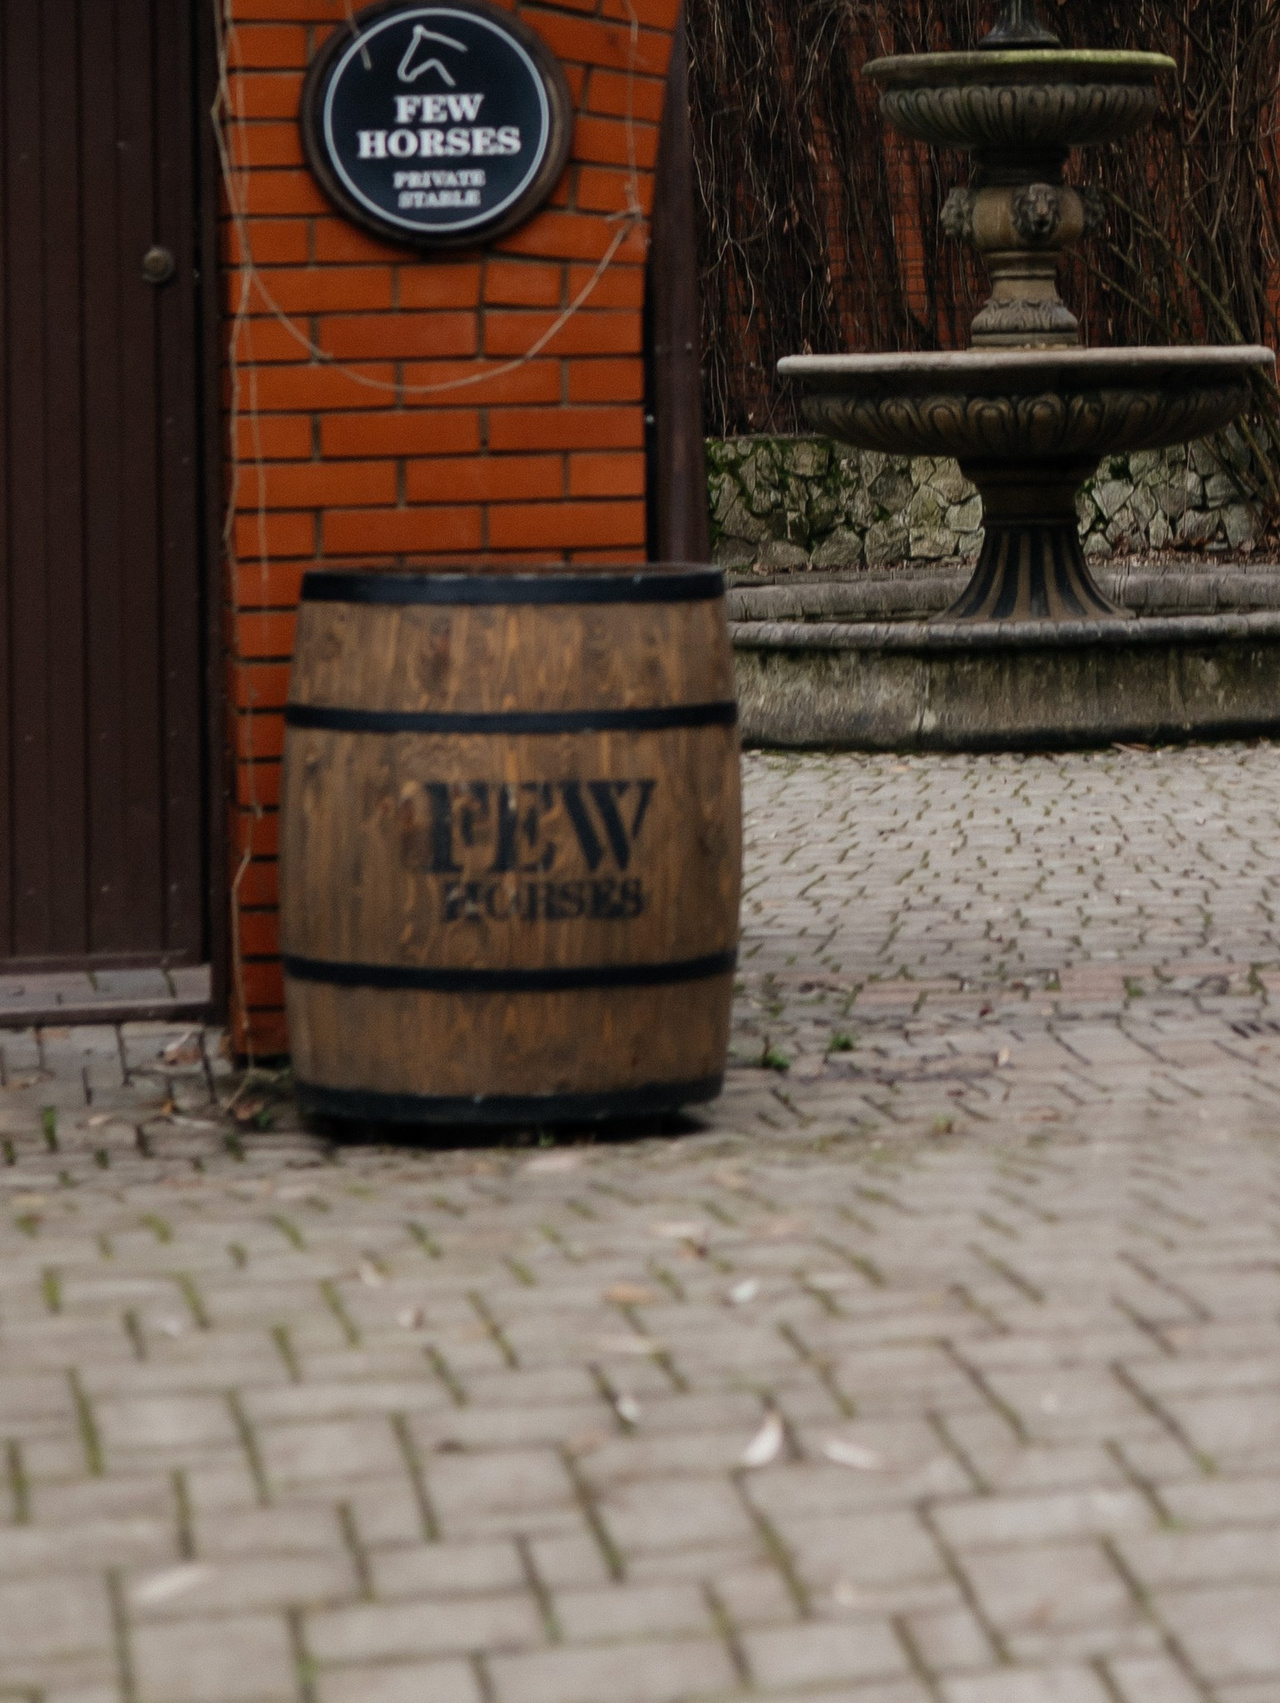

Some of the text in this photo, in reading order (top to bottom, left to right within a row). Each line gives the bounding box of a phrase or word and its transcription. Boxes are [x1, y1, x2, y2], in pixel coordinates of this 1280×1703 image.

[395, 94, 484, 124] FEW
[357, 126, 521, 158] HORSES
[394, 169, 485, 188] PRIVATE
[398, 190, 480, 208] STABLE
[425, 780, 656, 874] FEW
